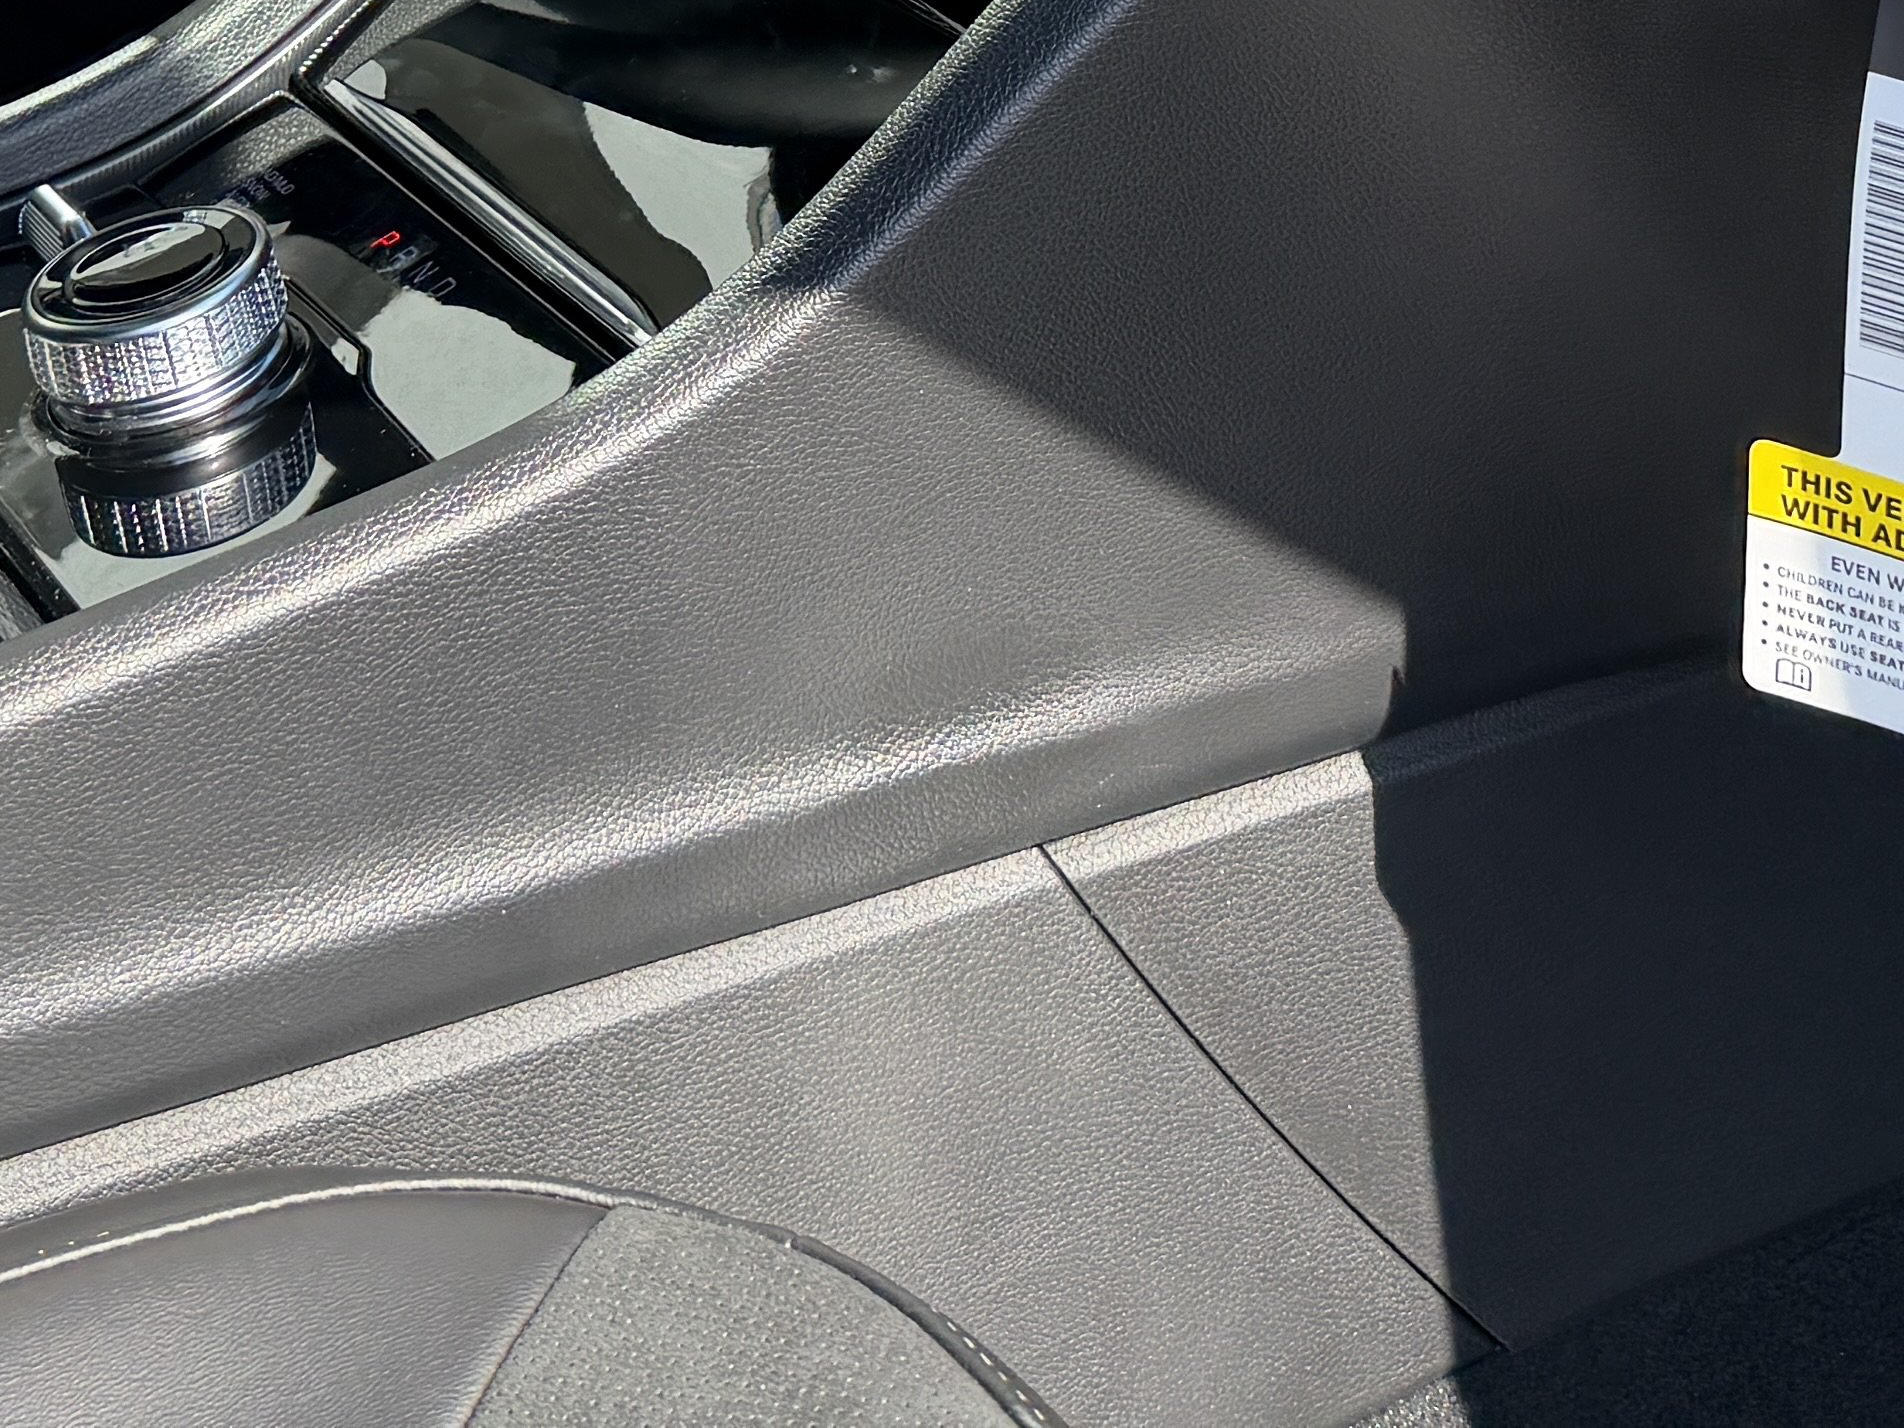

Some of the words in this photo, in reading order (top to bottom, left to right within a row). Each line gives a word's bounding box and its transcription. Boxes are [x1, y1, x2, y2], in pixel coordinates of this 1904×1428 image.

[370, 230, 401, 249] P
[1781, 464, 1853, 505] THIS
[1781, 494, 1861, 538] WITH
[1777, 566, 1843, 595] CHILDREN
[1847, 587, 1874, 605] CAN
[1878, 596, 1894, 612] BE
[1831, 556, 1880, 586] EVEN
[1777, 584, 1802, 602] THE
[1806, 593, 1846, 616] BACK
[1849, 606, 1884, 628] SEAT
[1888, 618, 1900, 633] IS
